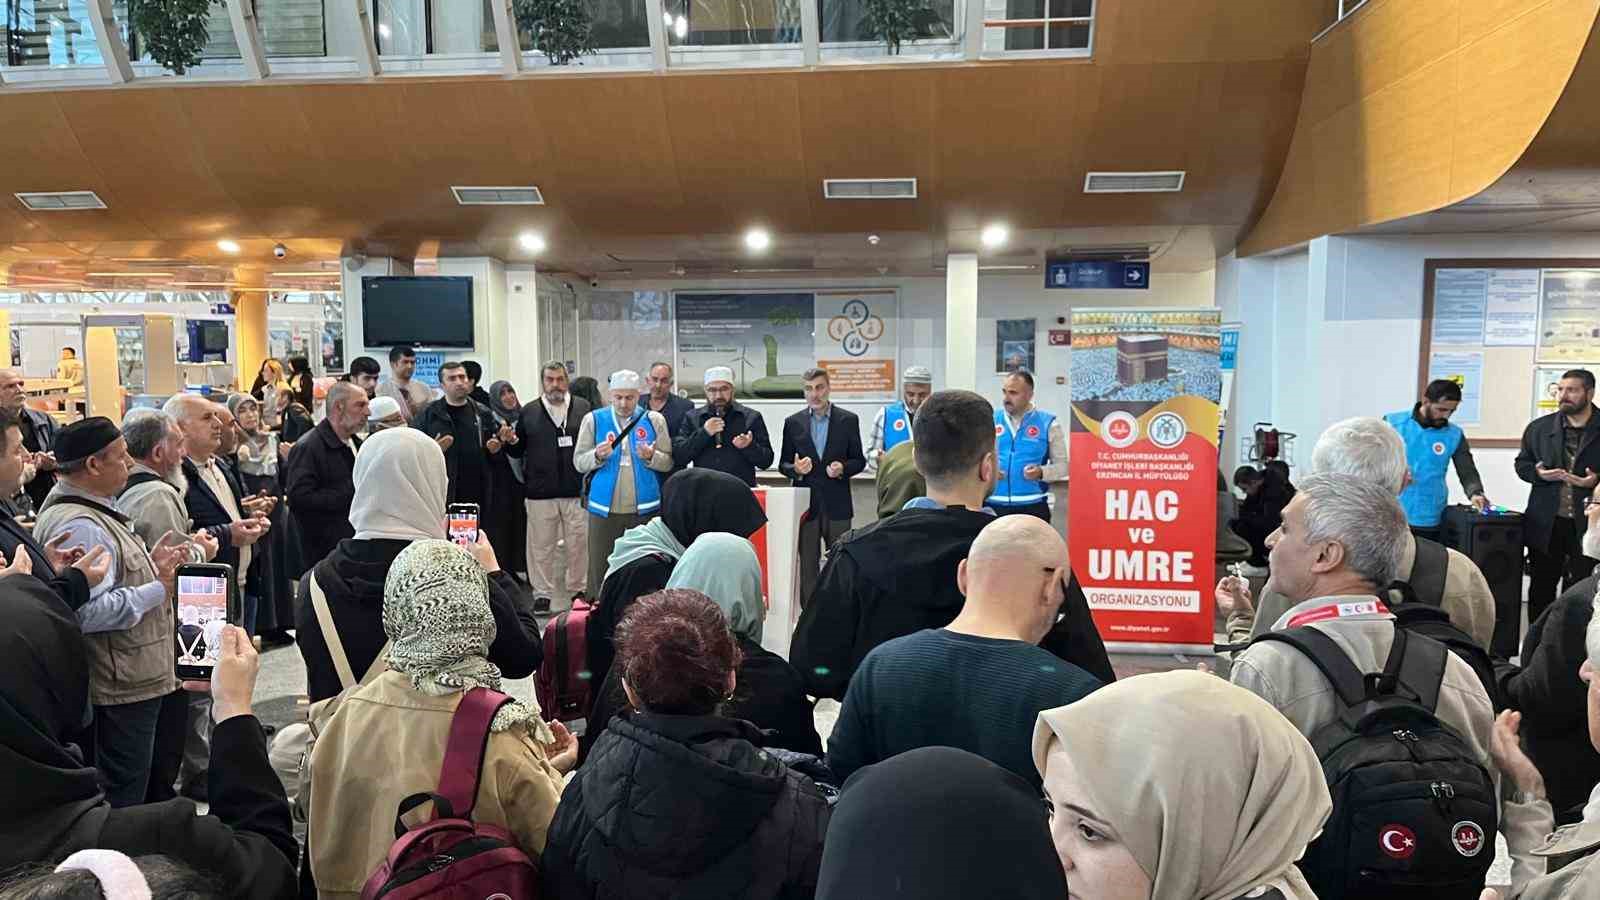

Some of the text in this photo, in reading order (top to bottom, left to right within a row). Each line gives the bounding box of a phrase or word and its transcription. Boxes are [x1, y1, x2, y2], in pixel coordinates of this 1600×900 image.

[1097, 452, 1189, 461] T.C. CUMHURBAŞKANLIĞI
[1091, 461, 1194, 471] DİYANET İŞLERİ BAŞKANLIĞI
[1096, 471, 1133, 480] ERZİNCAN
[1143, 471, 1189, 481] MÜFTÜLÜĞÜ
[1105, 489, 1179, 522] HAC
[1128, 527, 1155, 544] ve
[1088, 549, 1194, 583] UMRE
[1110, 624, 1170, 633] www.diyanet.gov.tr
